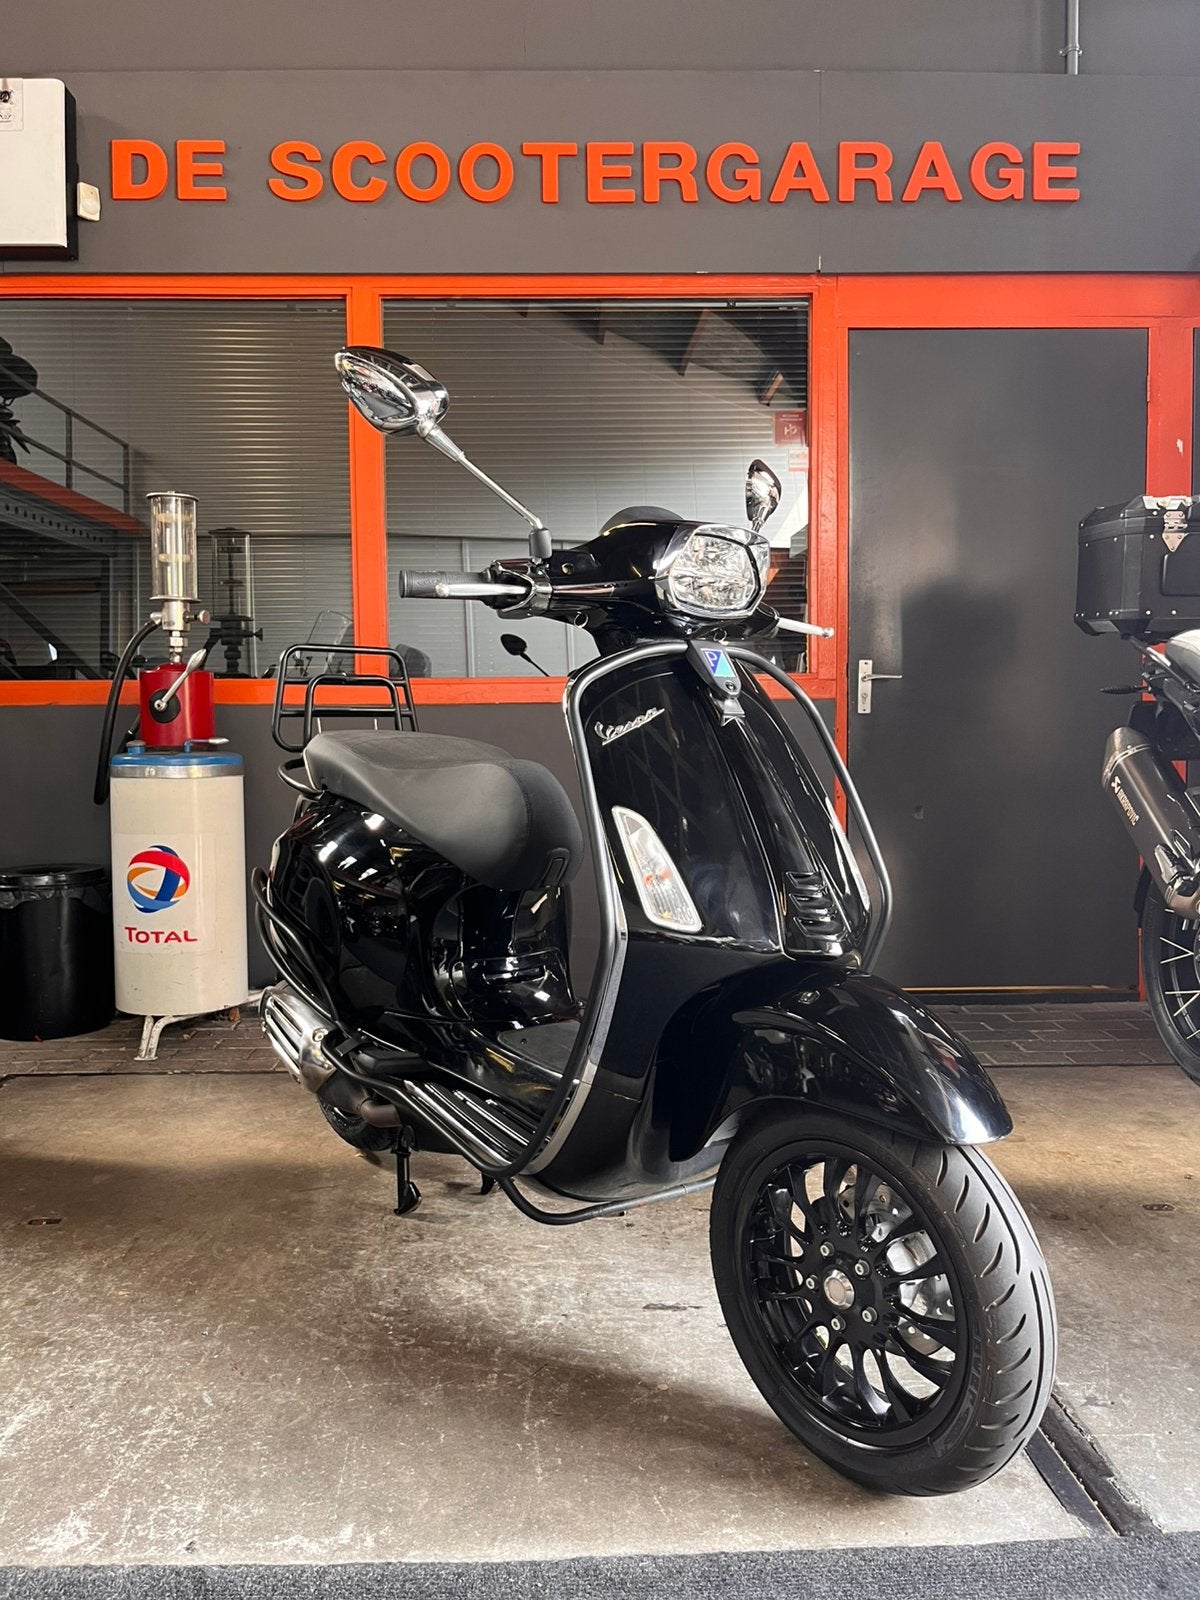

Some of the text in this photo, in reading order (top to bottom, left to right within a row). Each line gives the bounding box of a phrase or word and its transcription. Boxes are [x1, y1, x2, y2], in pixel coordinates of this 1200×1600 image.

[110, 139, 1081, 204] DE SCOOTERGARAGE
[594, 706, 665, 745] Vespa
[124, 926, 198, 944] TOTAL
